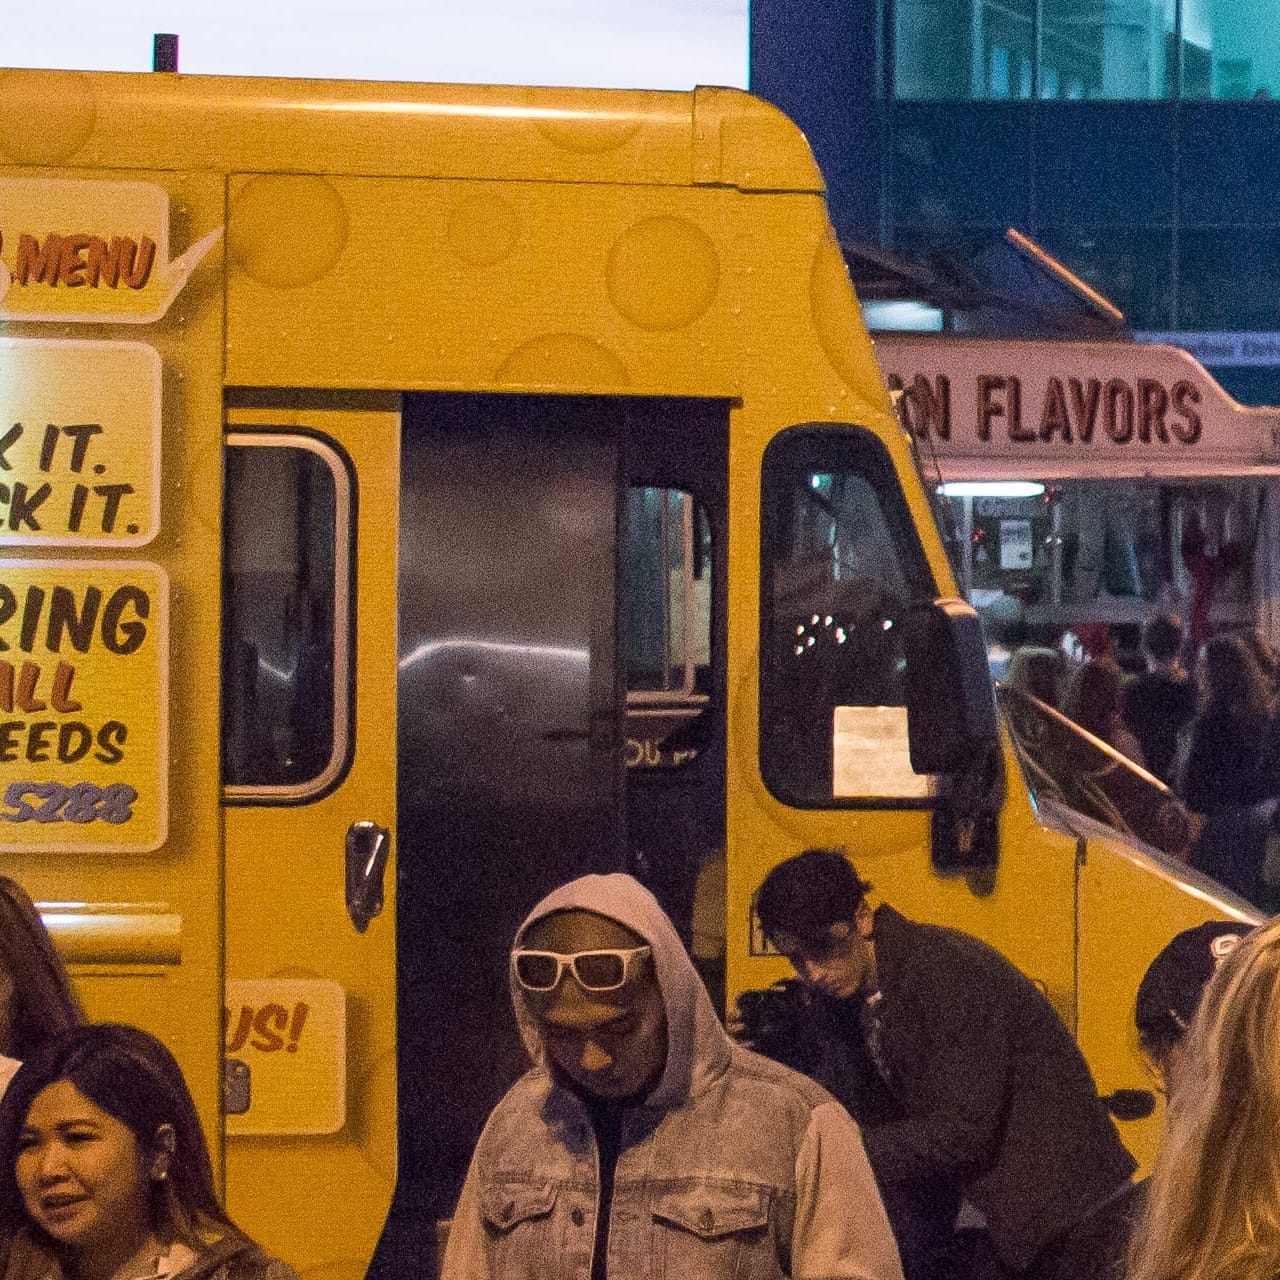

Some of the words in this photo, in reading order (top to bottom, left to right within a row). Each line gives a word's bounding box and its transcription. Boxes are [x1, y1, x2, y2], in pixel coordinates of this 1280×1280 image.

[17, 232, 156, 290] MENU
[977, 373, 1203, 444] FLAVORS
[39, 423, 106, 475] IT.
[0, 482, 52, 531] K
[68, 483, 140, 535] IT.
